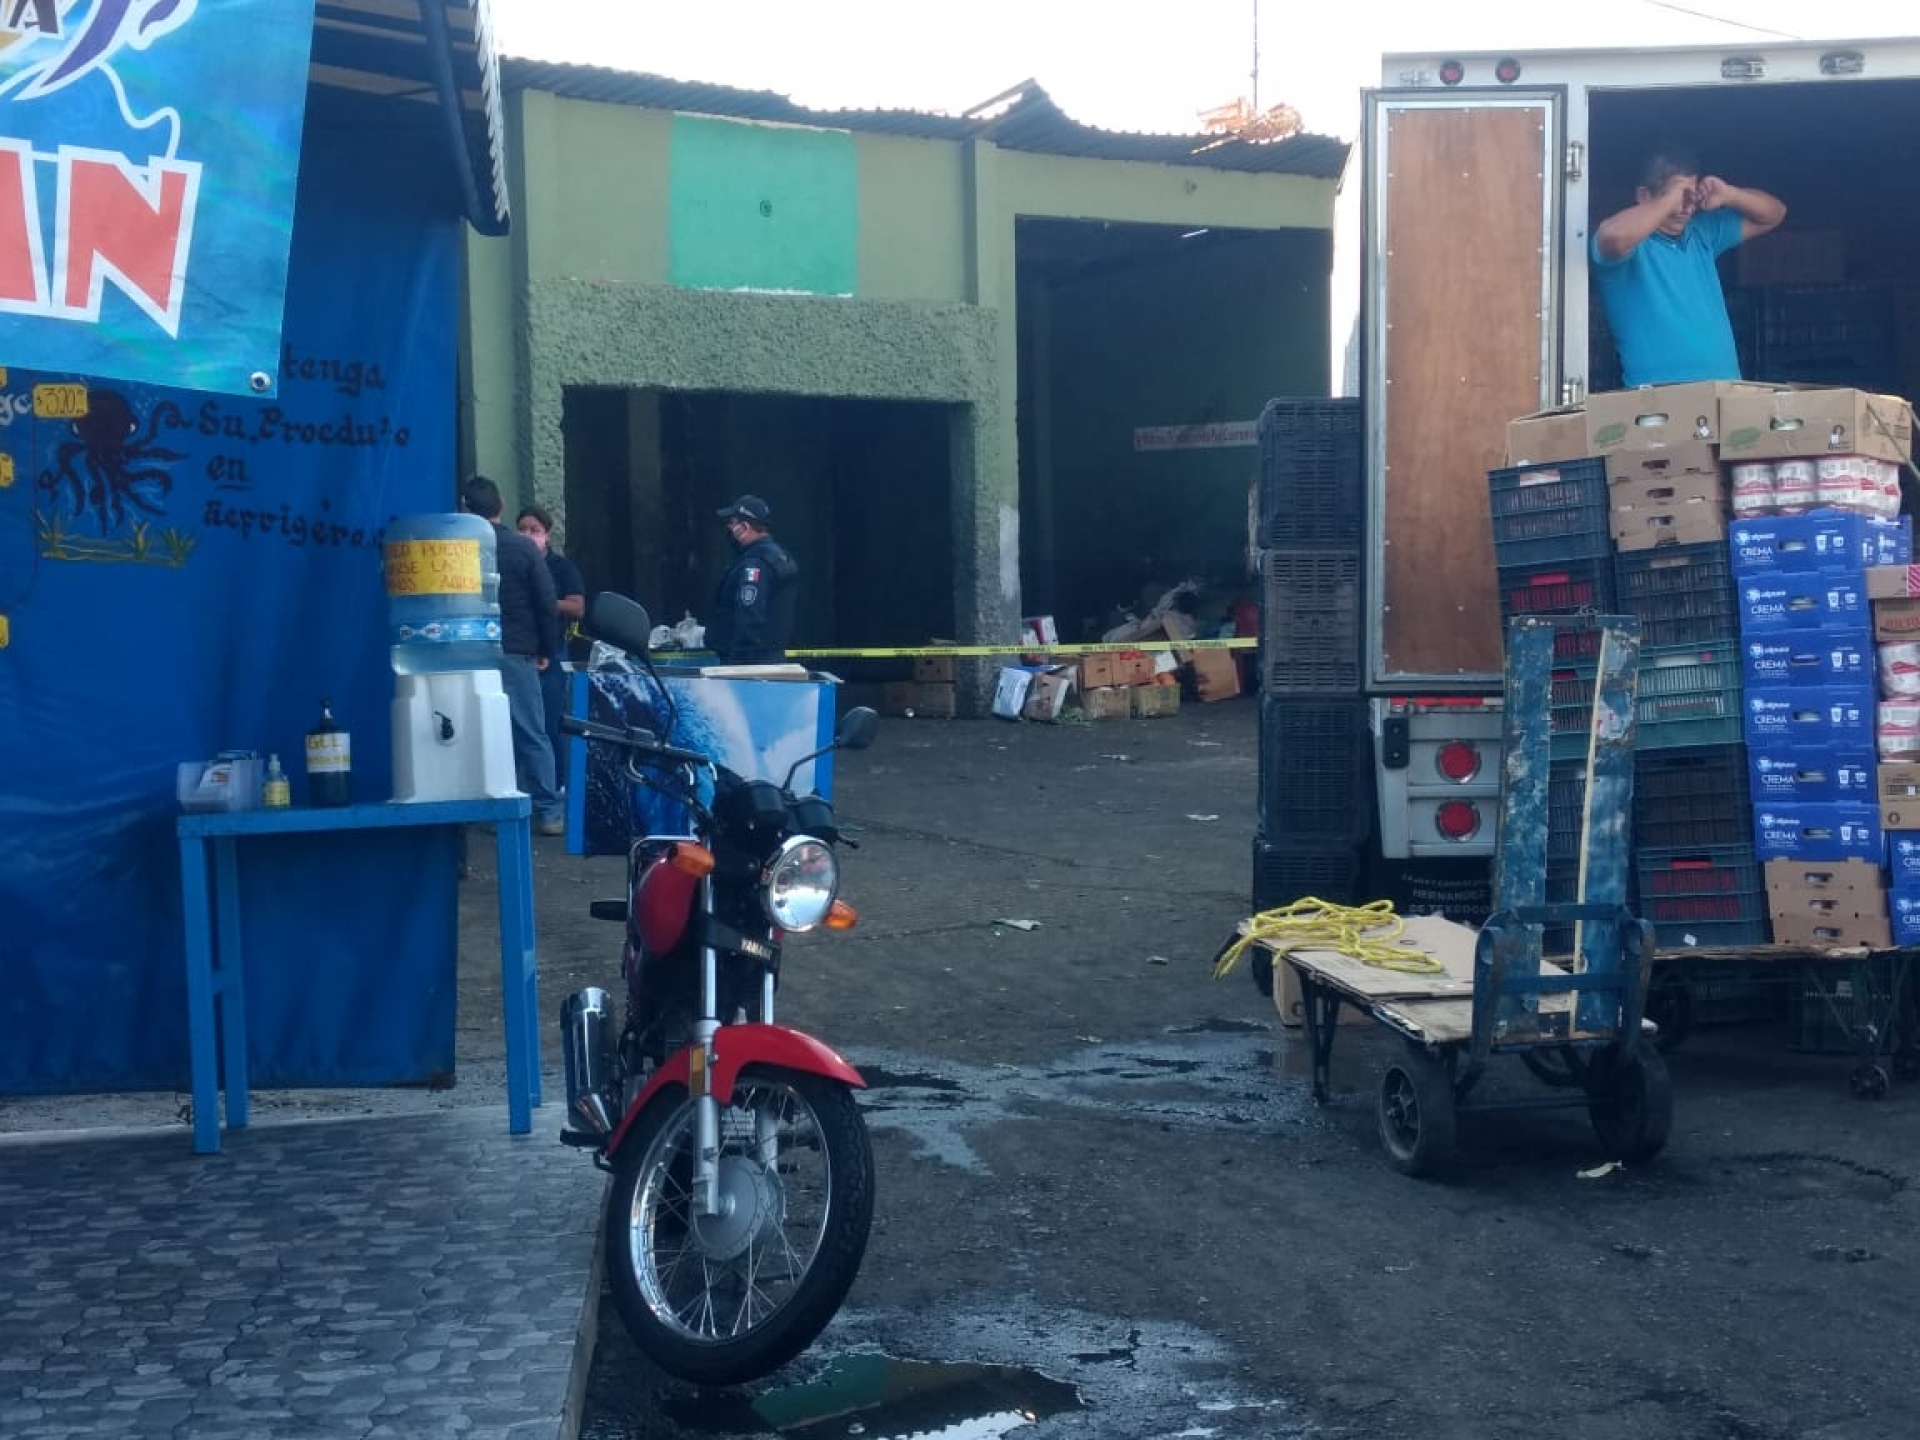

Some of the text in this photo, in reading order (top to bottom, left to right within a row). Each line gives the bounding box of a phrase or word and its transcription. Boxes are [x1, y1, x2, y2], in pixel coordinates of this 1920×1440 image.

[206, 454, 250, 482] en
[1751, 604, 1785, 614] CREMA
[1754, 659, 1787, 670] CREMA
[1754, 714, 1787, 725] CREMA
[1761, 774, 1795, 785] CREMA
[1764, 830, 1797, 841] CREMA
